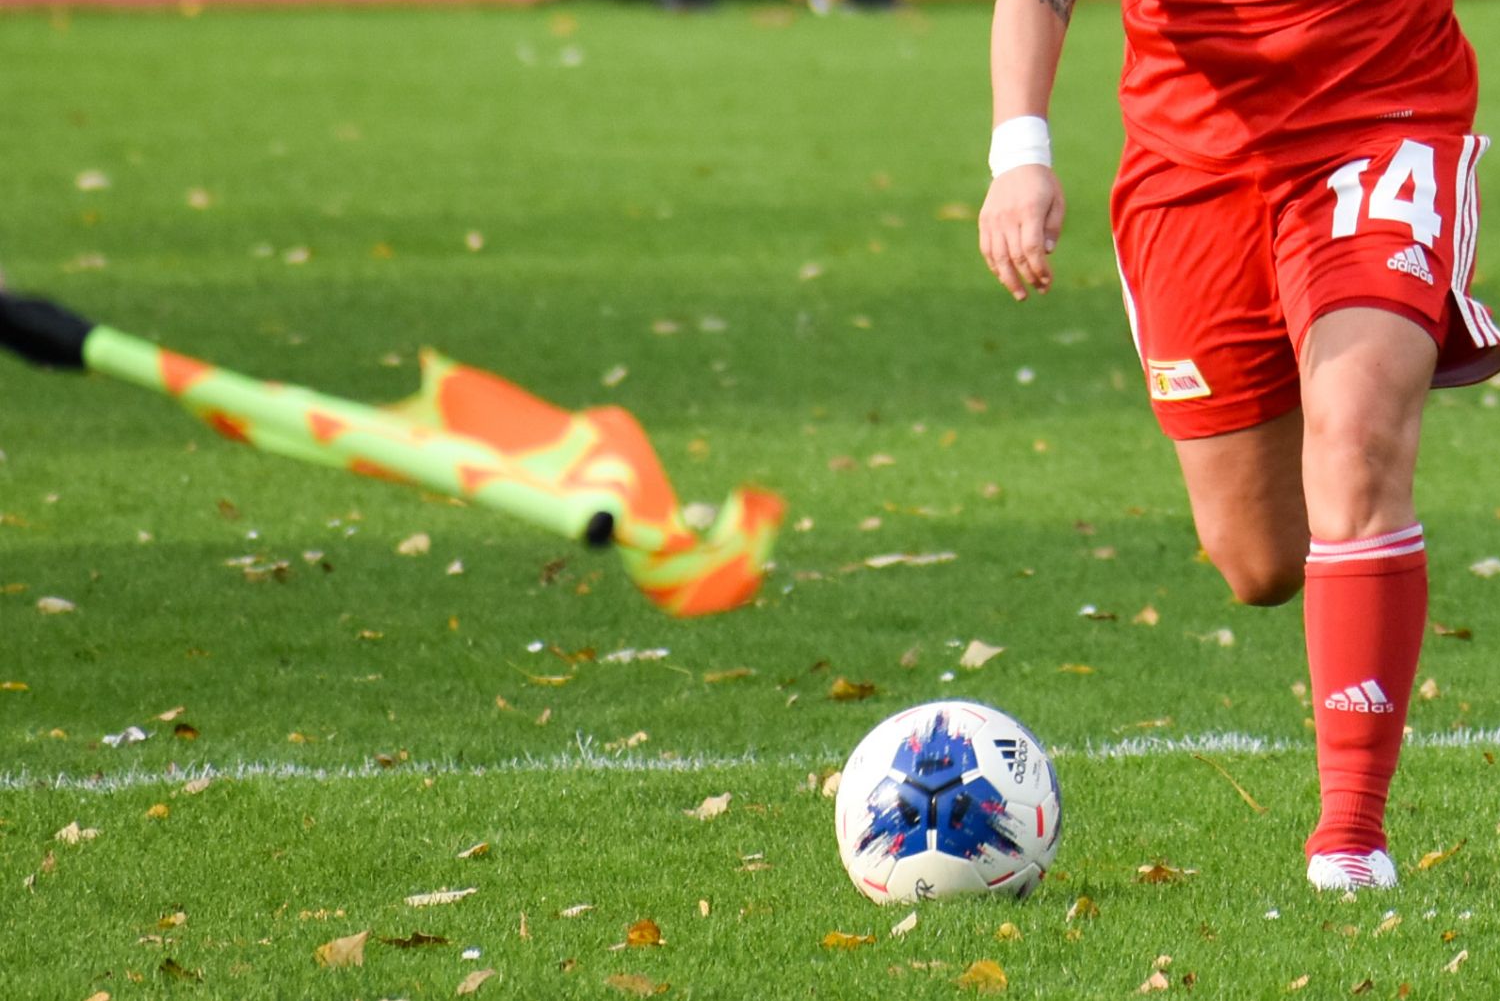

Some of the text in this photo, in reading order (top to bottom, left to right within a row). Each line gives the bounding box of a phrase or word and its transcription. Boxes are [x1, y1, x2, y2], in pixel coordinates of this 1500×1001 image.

[1326, 138, 1442, 249] 14
[1386, 256, 1434, 286] adidas
[1324, 699, 1394, 714] adidas
